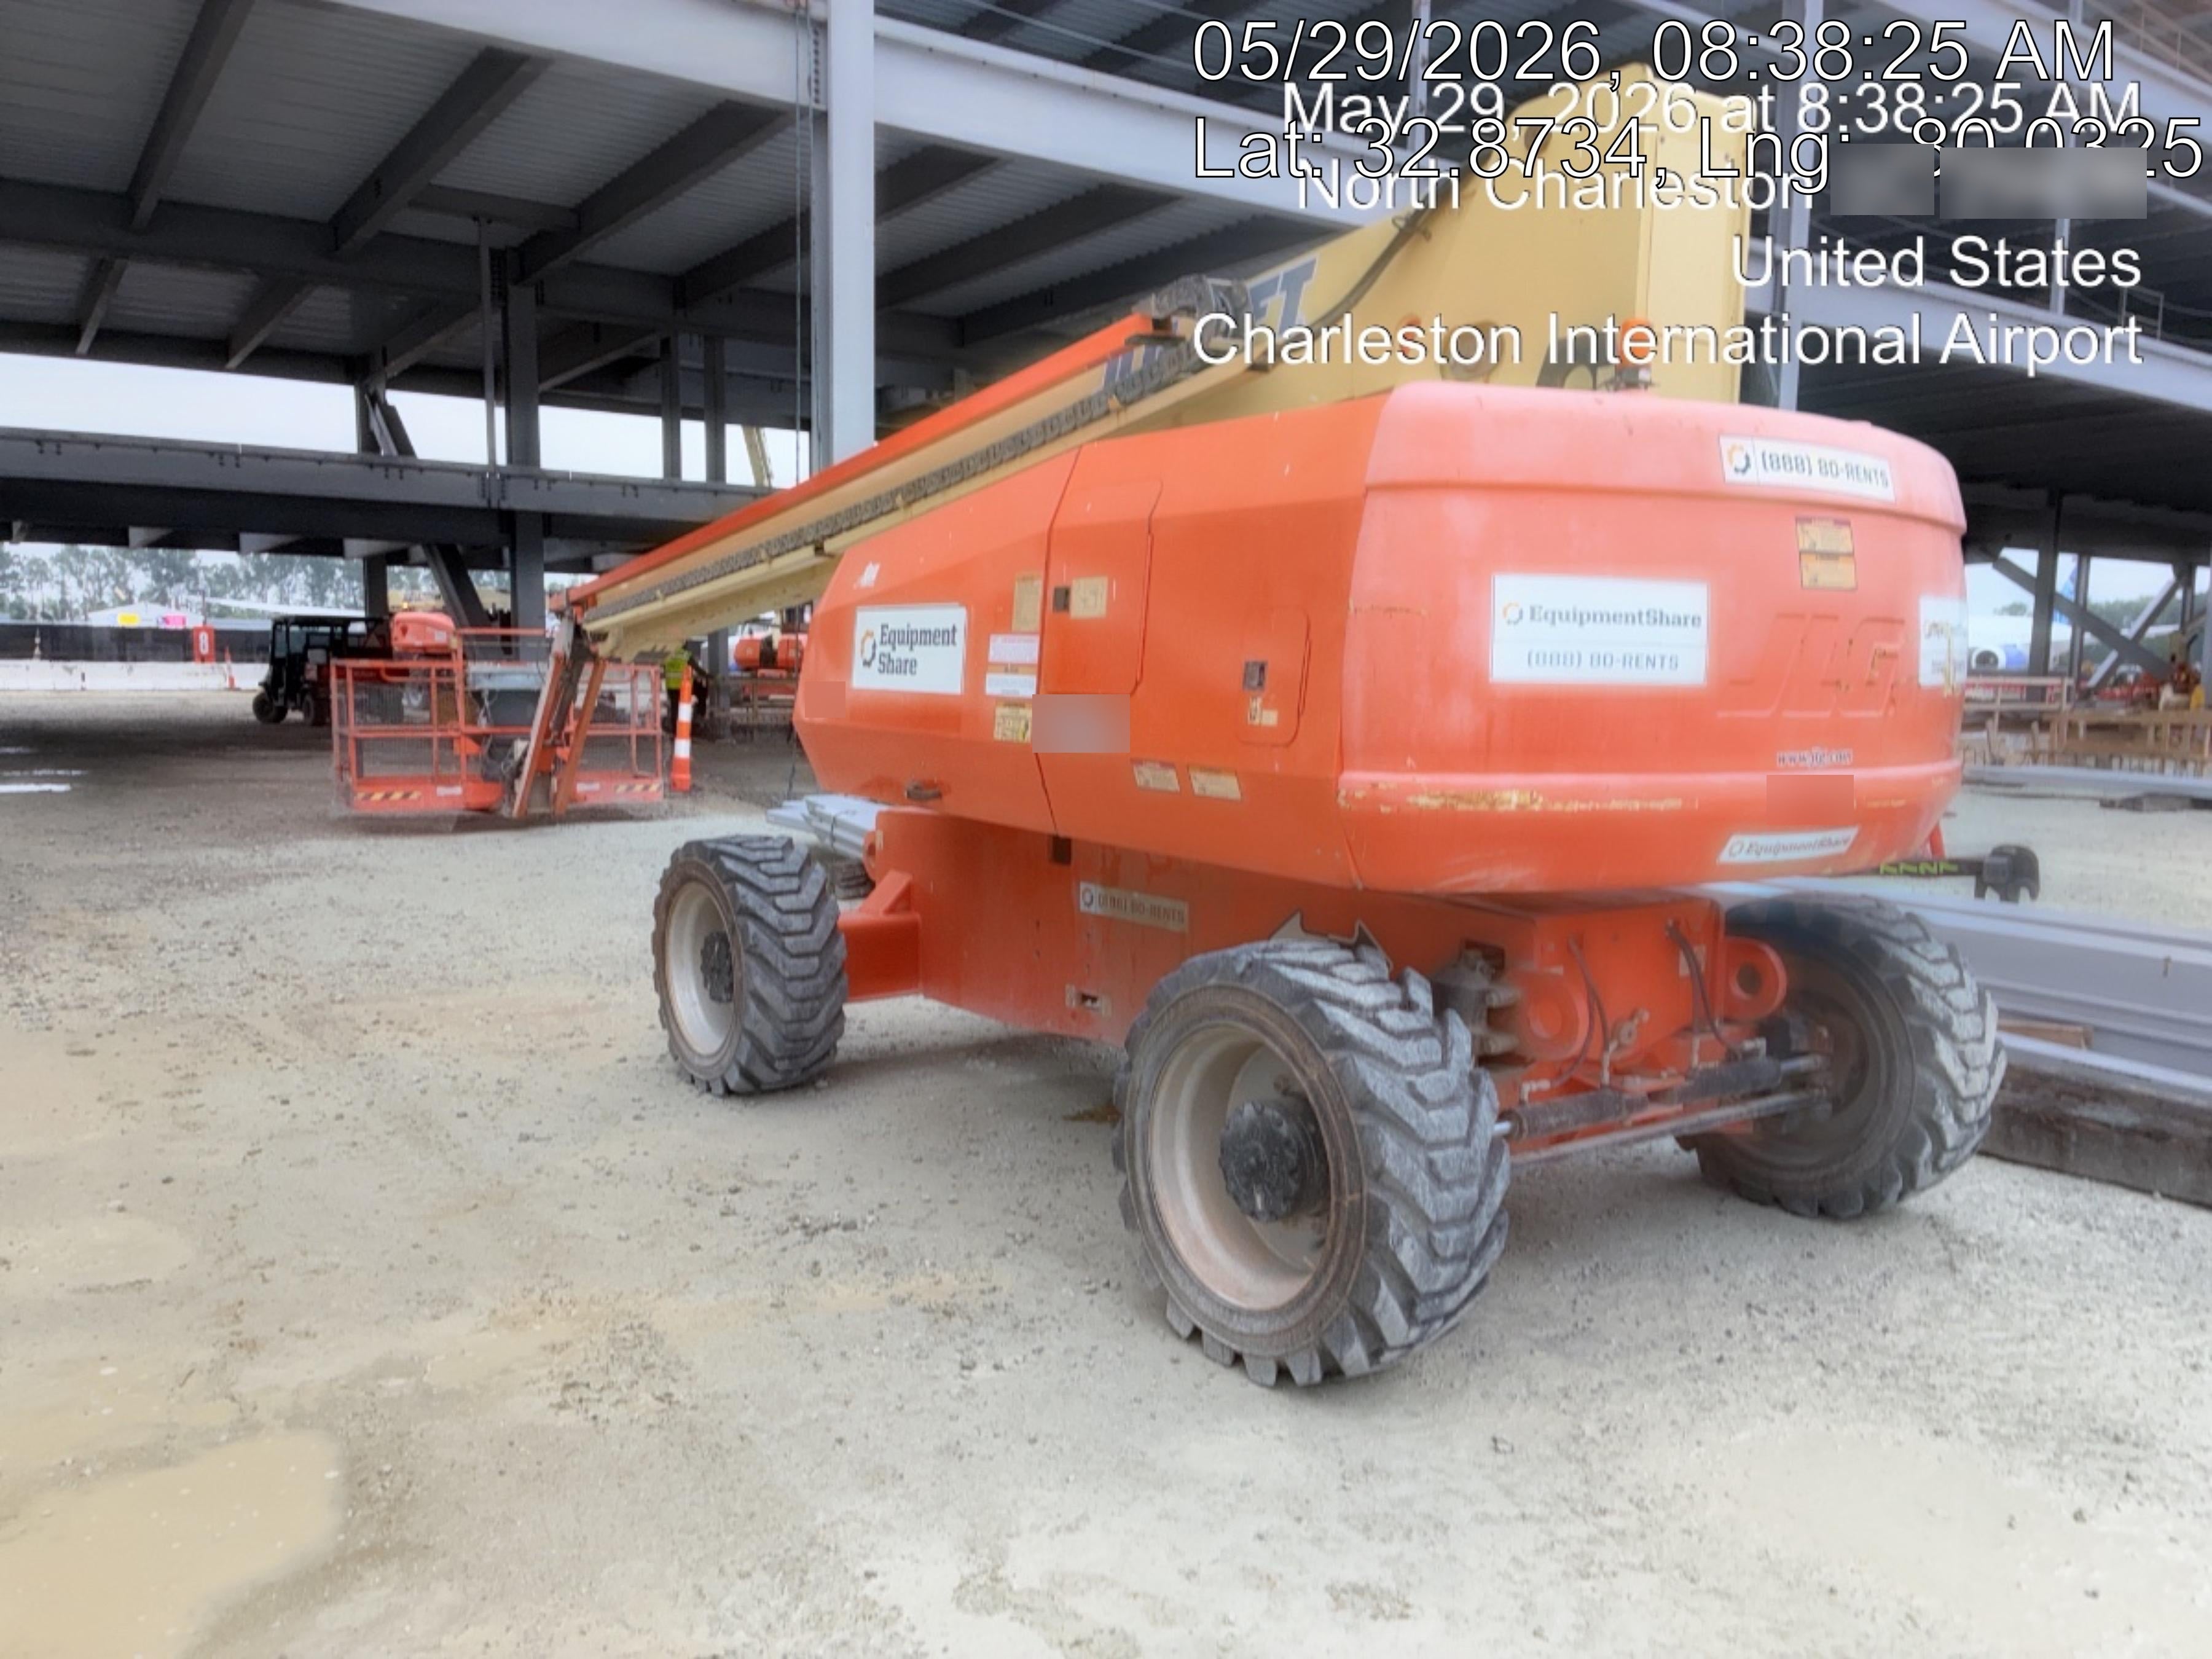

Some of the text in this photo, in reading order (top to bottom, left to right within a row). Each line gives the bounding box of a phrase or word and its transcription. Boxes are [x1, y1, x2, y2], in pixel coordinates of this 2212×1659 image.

[1528, 604, 1703, 629] EquipmentShare
[879, 622, 958, 652] Equipment
[877, 652, 919, 676] Share
